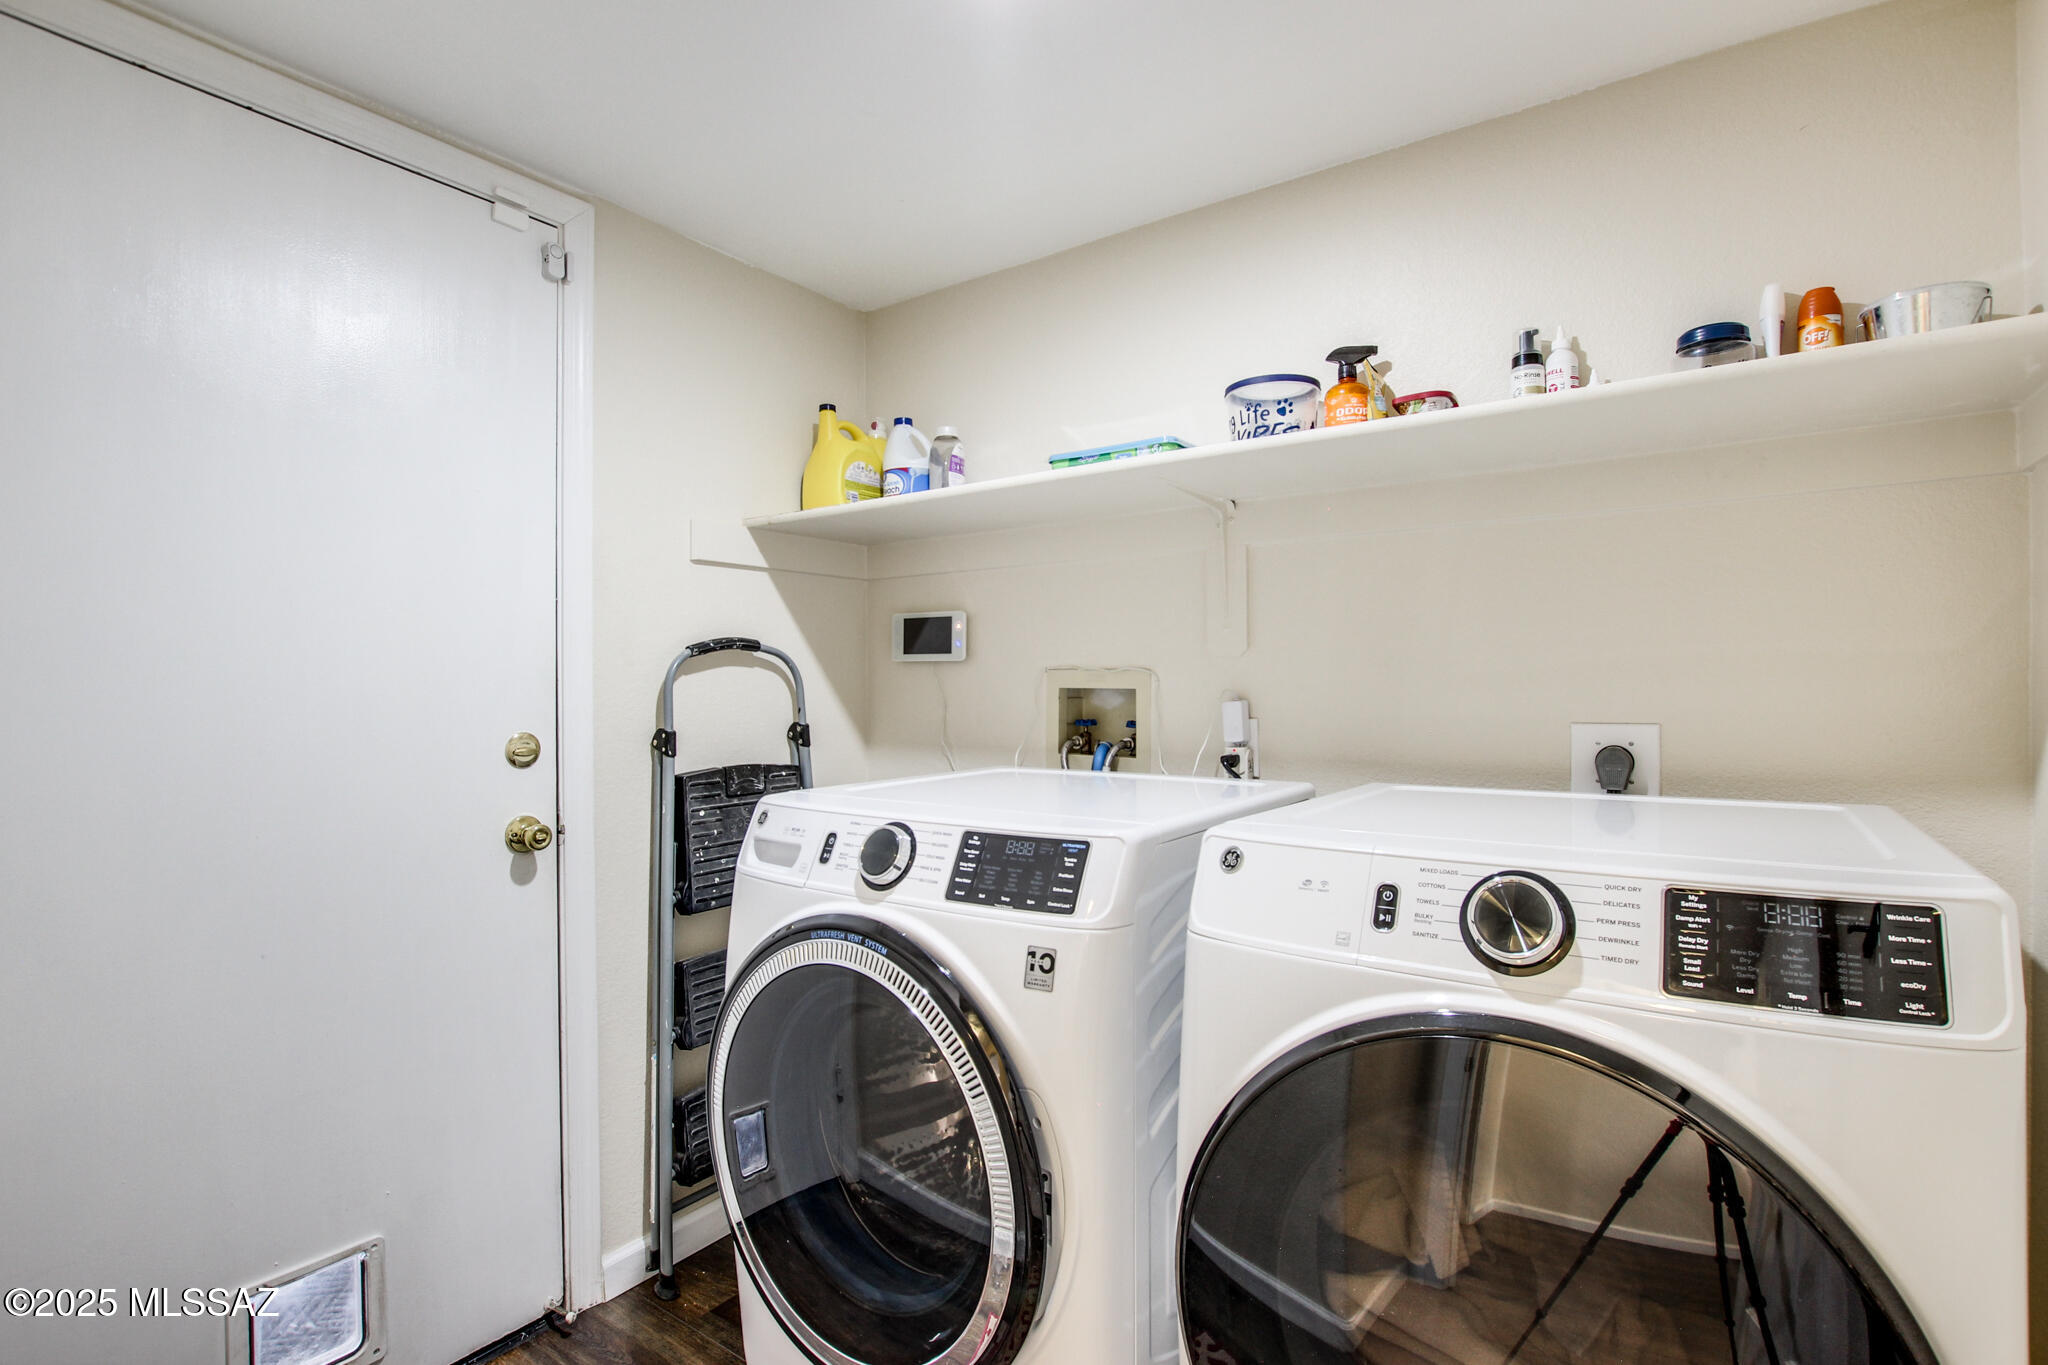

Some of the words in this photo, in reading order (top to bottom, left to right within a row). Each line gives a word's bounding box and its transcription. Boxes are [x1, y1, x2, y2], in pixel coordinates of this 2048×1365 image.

[1804, 329, 1829, 344] OFF!
[1240, 403, 1270, 426] Life
[1603, 901, 1641, 910] DELICATES
[1680, 901, 1707, 909] Settings
[1675, 914, 1694, 922] Damp
[1914, 915, 1931, 923] Care
[1412, 931, 1439, 939] SANITIZE
[1678, 935, 1696, 943] Delay
[811, 930, 845, 939] ULTRAFRESH
[847, 933, 863, 942] VENT
[864, 938, 888, 955] SYSTEM
[1598, 936, 1640, 946] DEWRINKLE
[1907, 936, 1926, 944] Time
[1028, 951, 1055, 974] 10
[1601, 955, 1623, 963] TIMED
[1683, 957, 1702, 965] Small
[1682, 980, 1704, 988] Sound
[1901, 982, 1926, 990] ecoDry
[1736, 986, 1755, 994] Level
[1787, 992, 1808, 1001] Temp
[1843, 998, 1862, 1006] Time
